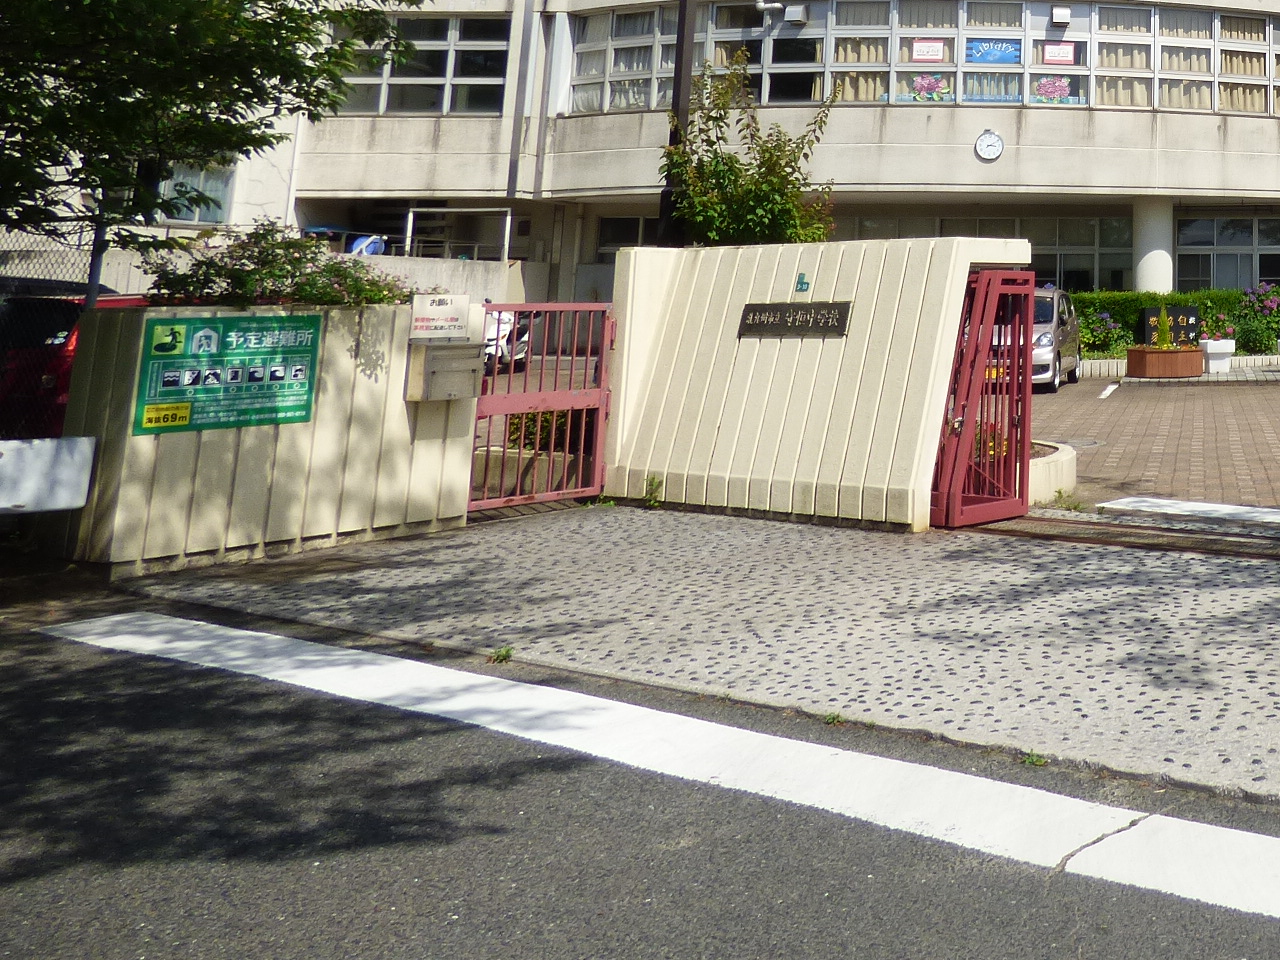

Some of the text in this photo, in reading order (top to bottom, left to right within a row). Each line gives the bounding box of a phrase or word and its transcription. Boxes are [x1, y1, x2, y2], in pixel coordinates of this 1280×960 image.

[973, 40, 1014, 57] Library
[429, 298, 453, 307] お願い
[225, 329, 314, 349] 予定避難所
